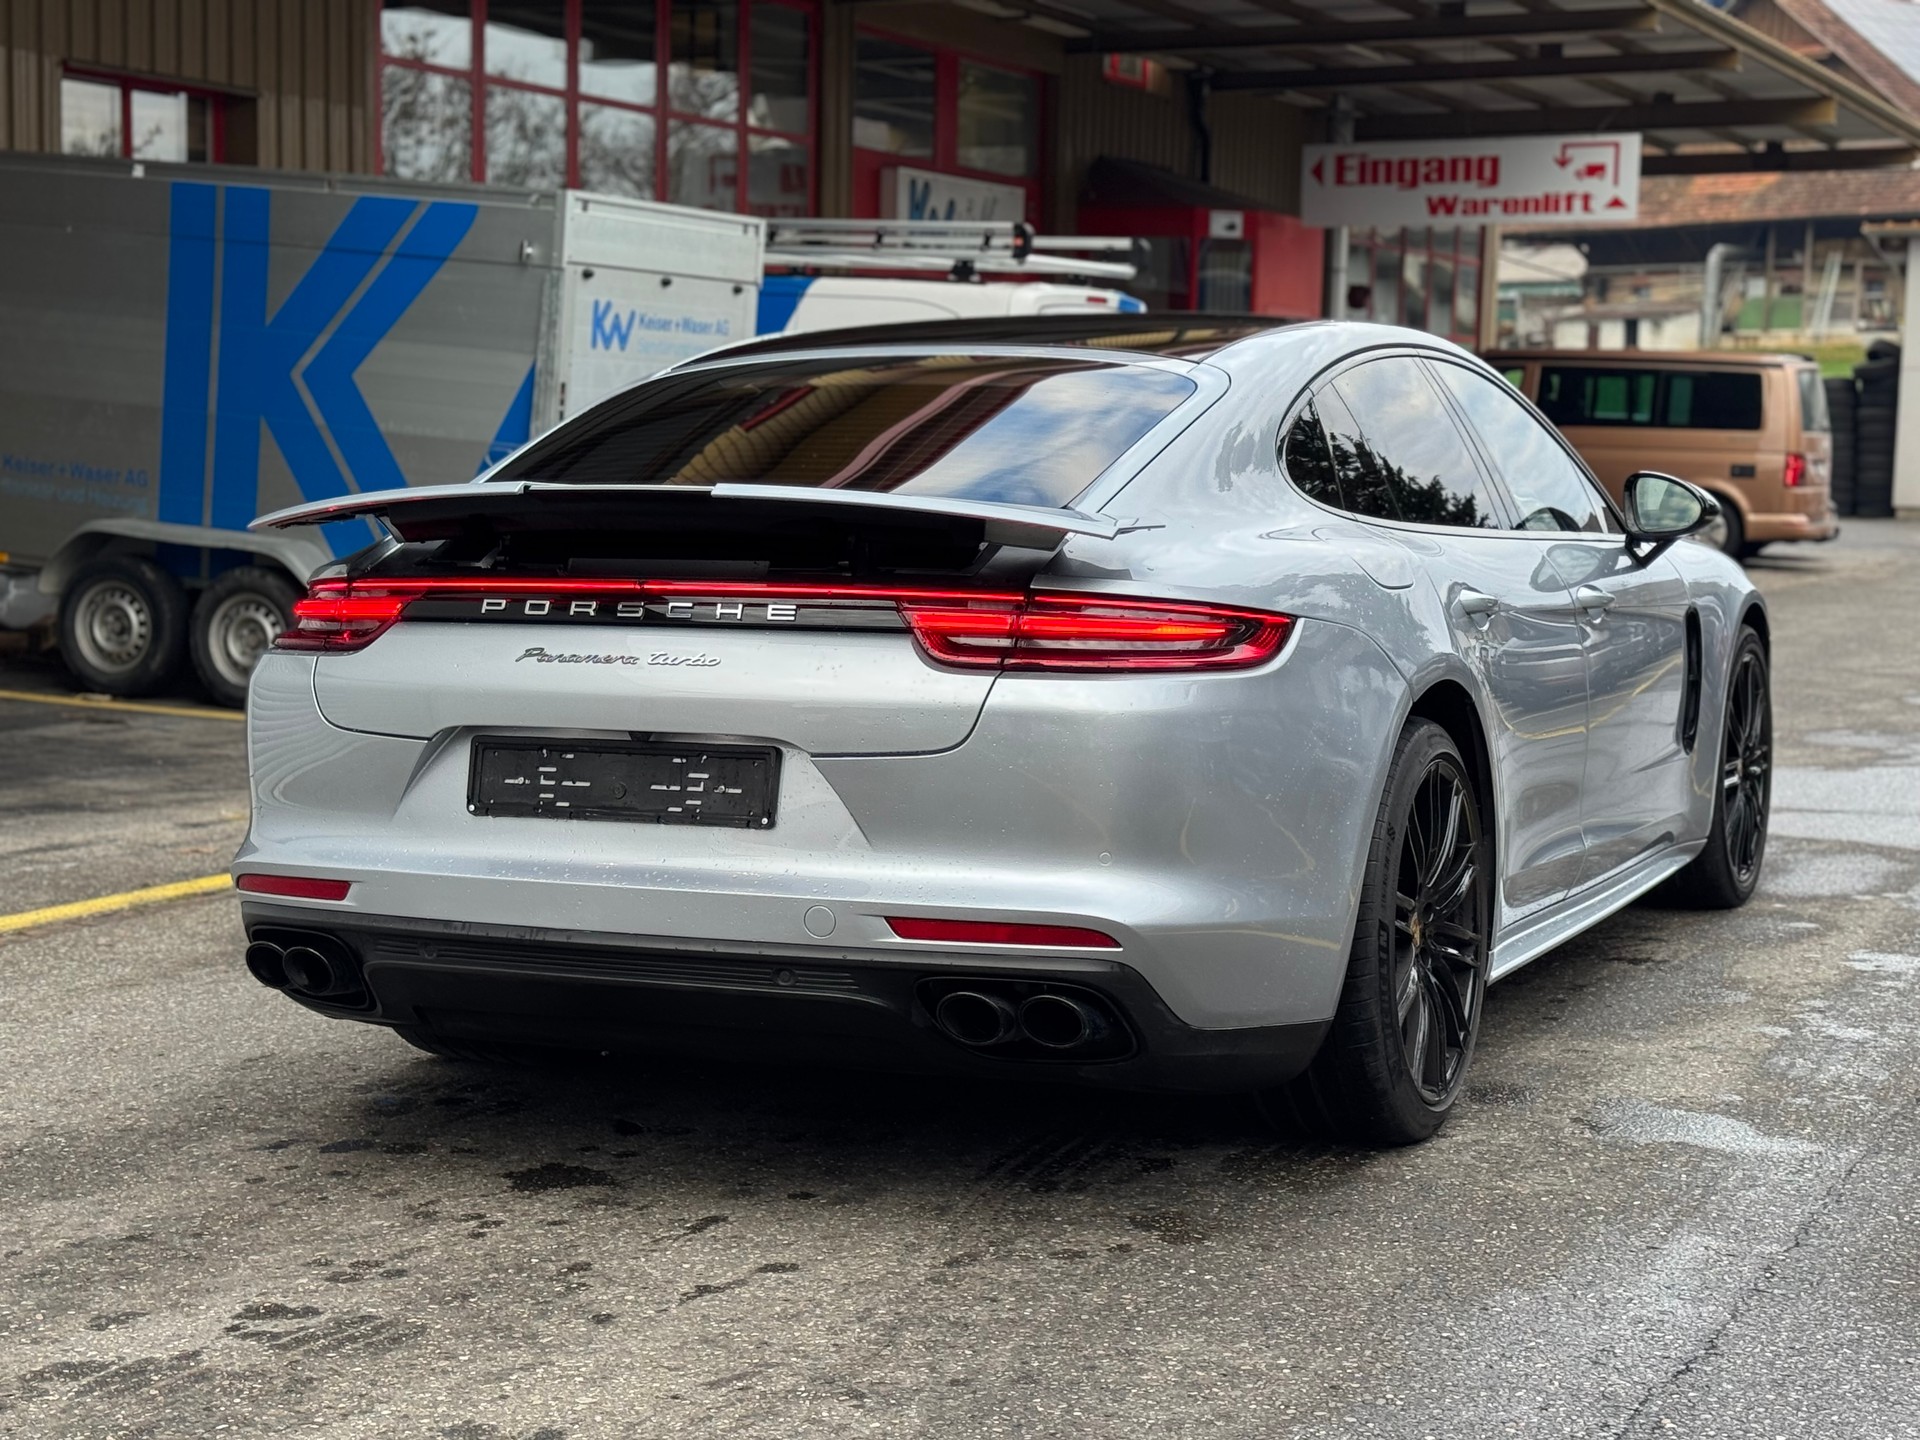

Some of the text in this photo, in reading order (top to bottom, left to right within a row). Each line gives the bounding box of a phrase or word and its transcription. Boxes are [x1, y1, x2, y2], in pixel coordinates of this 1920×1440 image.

[1333, 153, 1500, 190] Eingang
[1426, 192, 1594, 217] Warenlift
[591, 299, 636, 351] KW
[124, 468, 149, 488] AG
[481, 598, 797, 622] PORSCHE
[515, 647, 640, 665] Panamera
